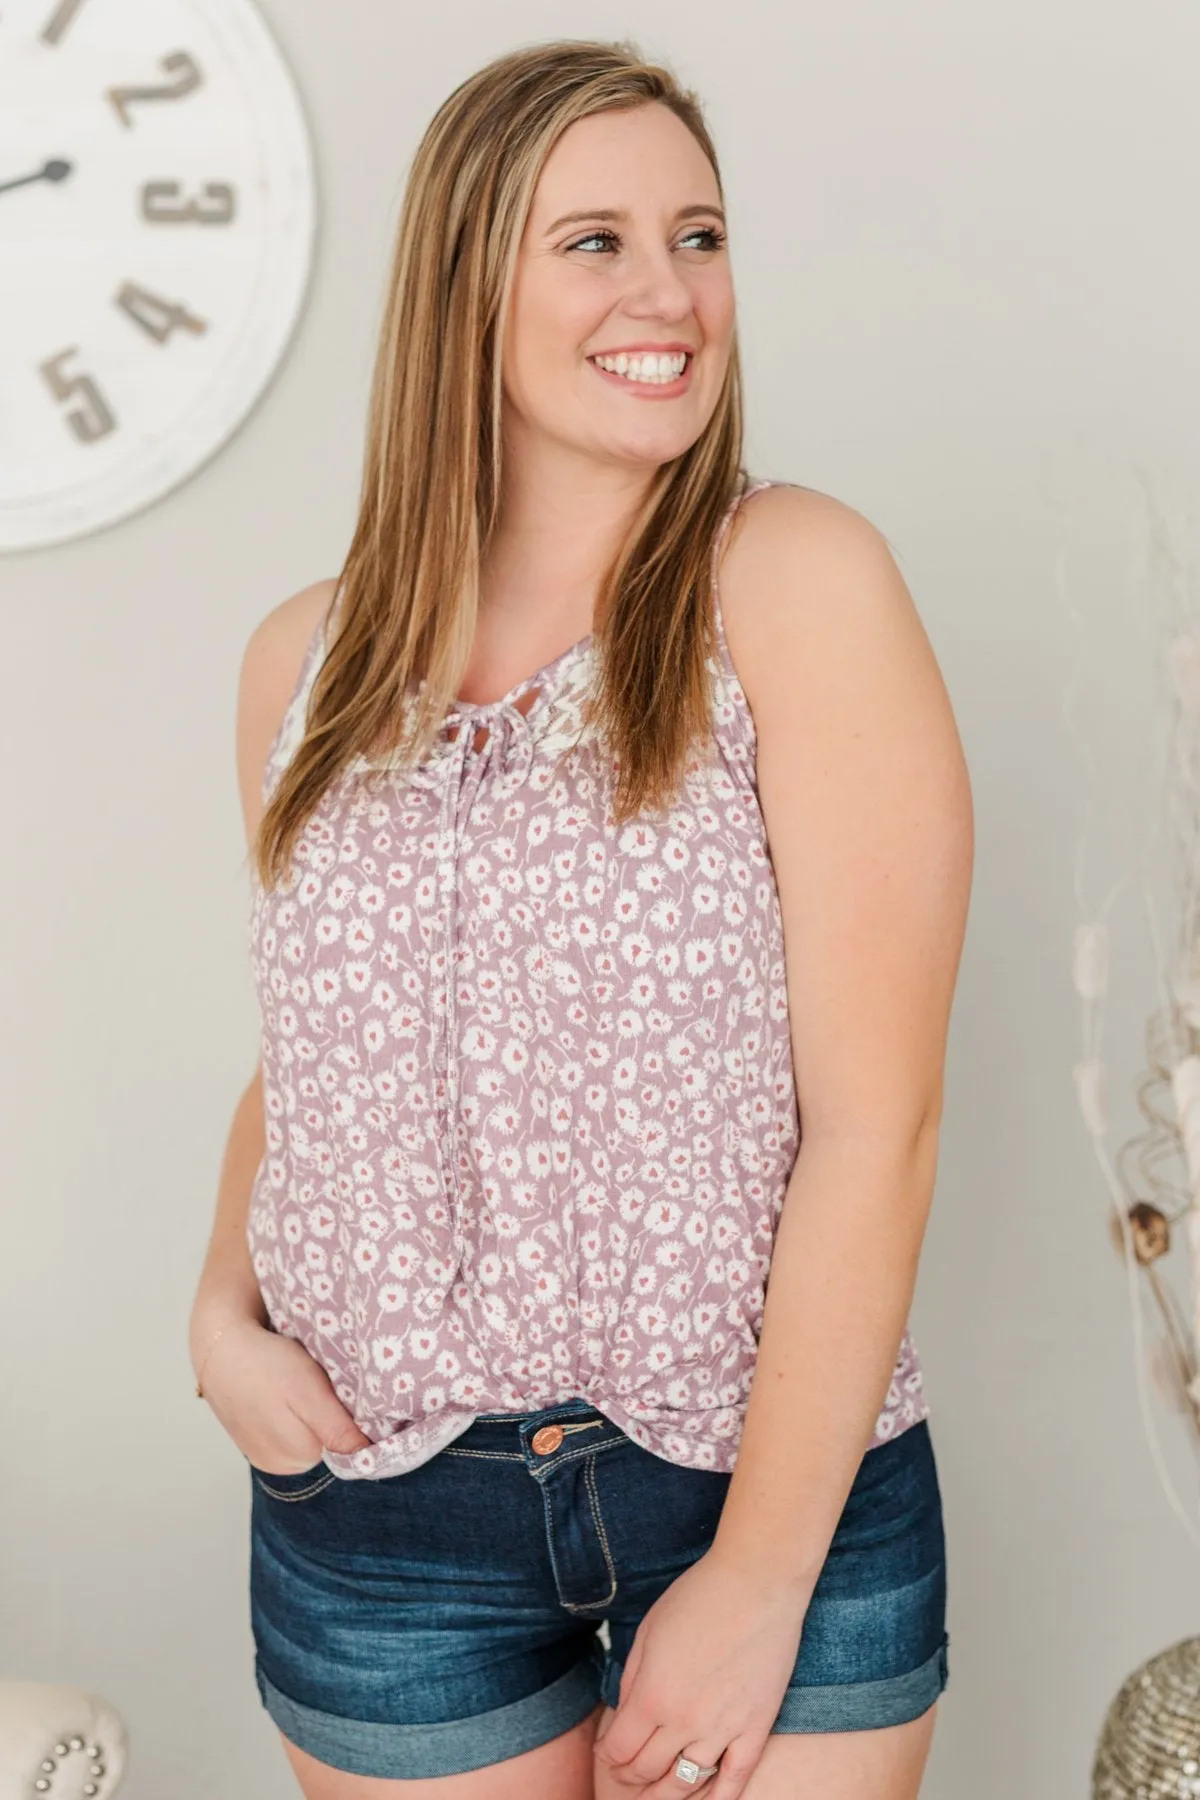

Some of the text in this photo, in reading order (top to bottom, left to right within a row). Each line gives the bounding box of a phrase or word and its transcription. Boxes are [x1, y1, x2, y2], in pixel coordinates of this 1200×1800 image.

[106, 50, 205, 130] 2
[139, 179, 237, 227] 3
[113, 280, 208, 347] 4
[39, 347, 118, 445] 5
